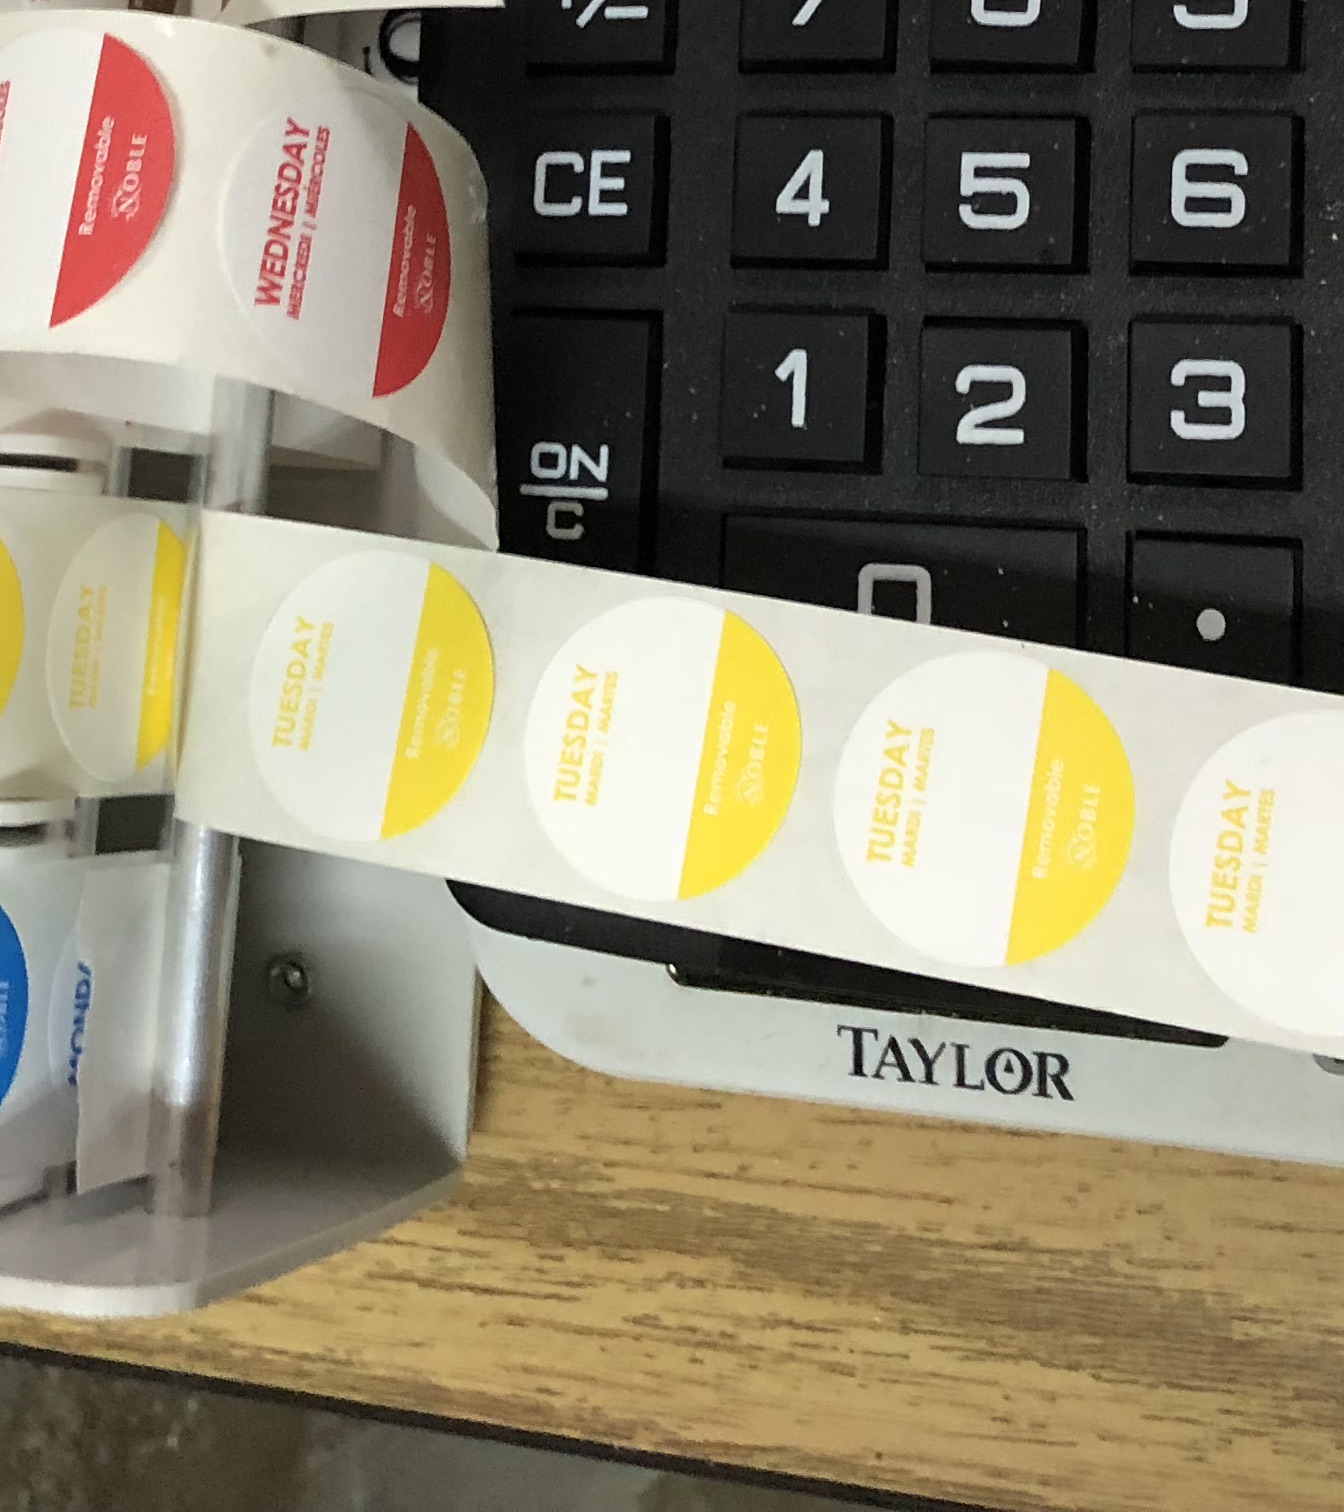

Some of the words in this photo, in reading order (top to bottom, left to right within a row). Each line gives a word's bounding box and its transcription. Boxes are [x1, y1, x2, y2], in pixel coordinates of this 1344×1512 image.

[77, 113, 116, 238] Removable
[109, 131, 148, 224] NOBLE
[254, 114, 313, 308] WEDNESDAY
[532, 149, 632, 218] CE
[774, 148, 831, 227] 4
[957, 151, 1031, 230] 5
[1169, 147, 1249, 229] 6
[285, 229, 313, 321] MERCREDI
[392, 202, 417, 319] Removable
[774, 348, 809, 429] 1
[954, 363, 1028, 446] 2
[1169, 357, 1247, 441] 3
[528, 441, 610, 484] ON
[545, 500, 585, 542] C
[68, 583, 94, 710] TUESDAY
[272, 615, 316, 749] TUESDAY
[405, 648, 439, 760] Removable
[554, 663, 599, 805] TUESDAY
[584, 750, 606, 807] MARDI
[599, 670, 619, 734] MARTES
[702, 699, 736, 816] Removable
[866, 719, 913, 866] TUESDAY
[900, 807, 923, 868] MARDI
[912, 727, 935, 793] MARTES
[1031, 758, 1066, 880] Removable
[1065, 779, 1102, 872] NOBLE
[1204, 778, 1251, 931] TUESDAY
[1242, 873, 1265, 935] MARDI
[1254, 787, 1276, 857] MARTES
[836, 1023, 1076, 1102] TAYLOR
